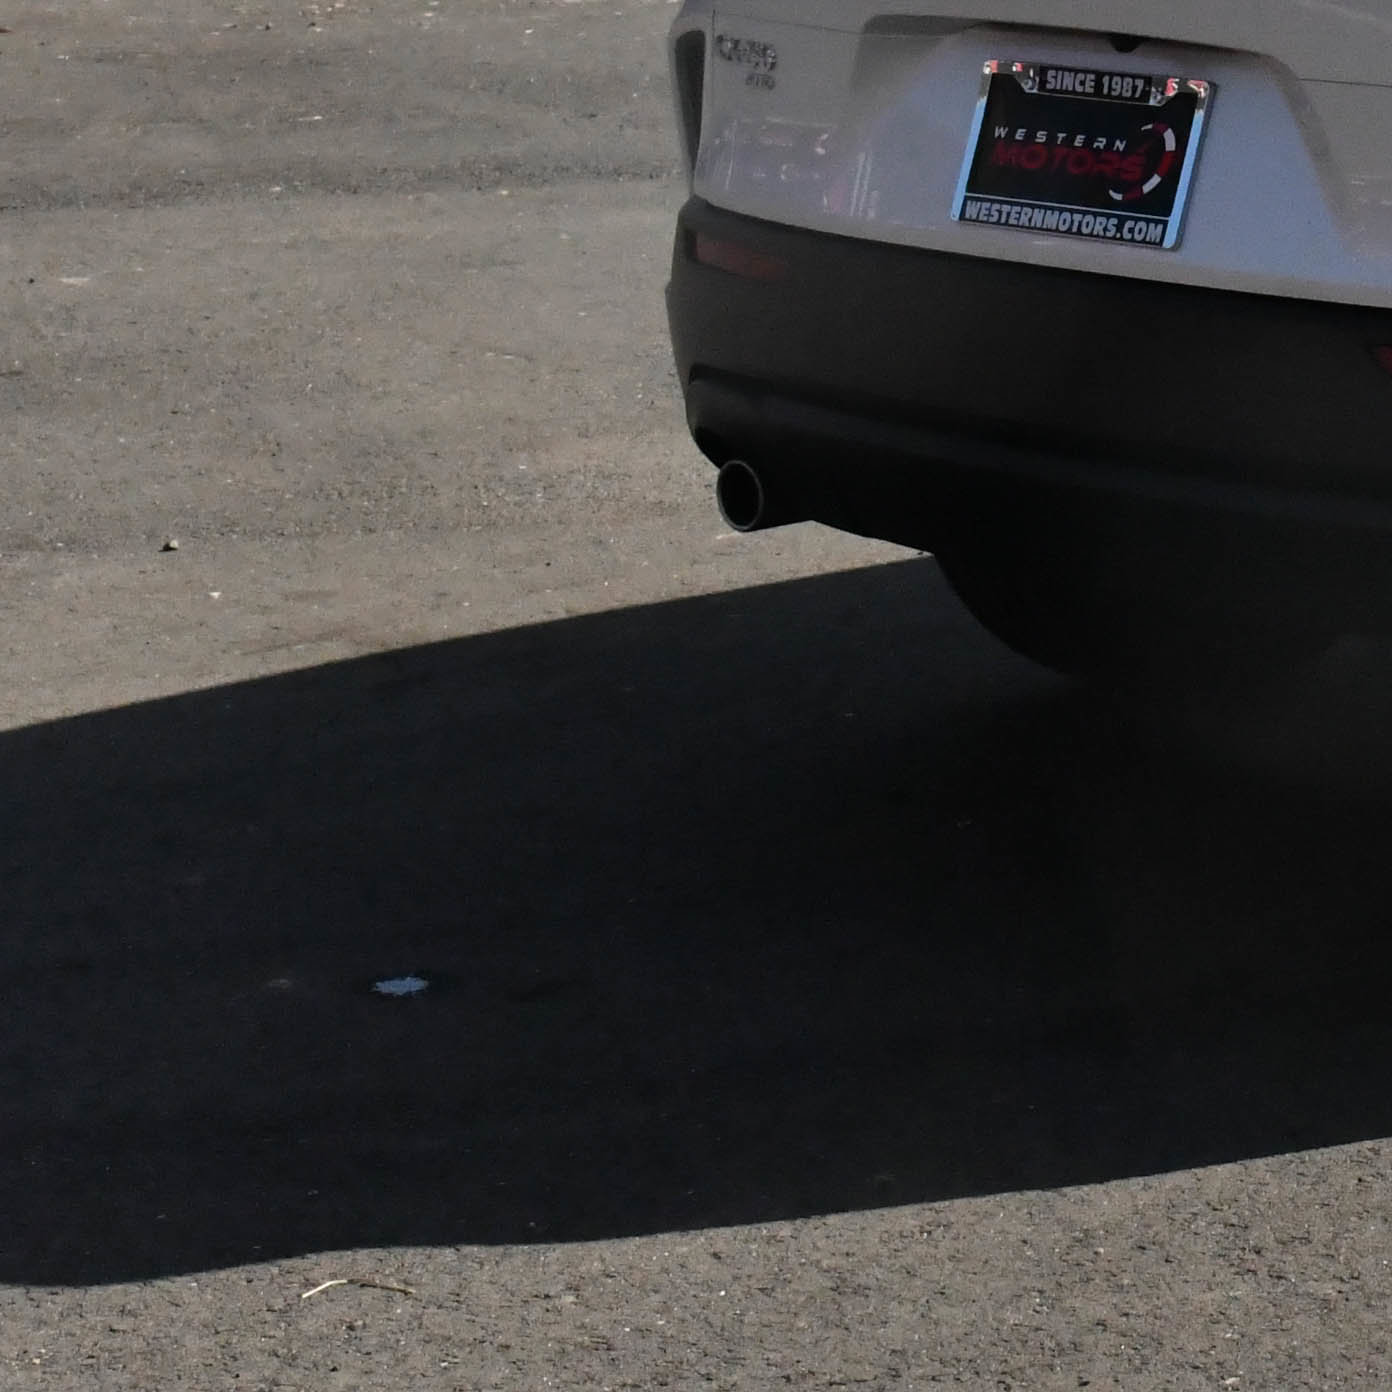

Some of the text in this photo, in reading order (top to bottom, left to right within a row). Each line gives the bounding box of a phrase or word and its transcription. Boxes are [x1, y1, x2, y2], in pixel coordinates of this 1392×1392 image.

[1046, 70, 1144, 98] SINCE 1987
[994, 126, 1128, 152] WESTERN
[991, 141, 1146, 182] MOTORS
[964, 200, 1164, 243] WESTERNMOTORS.COM
